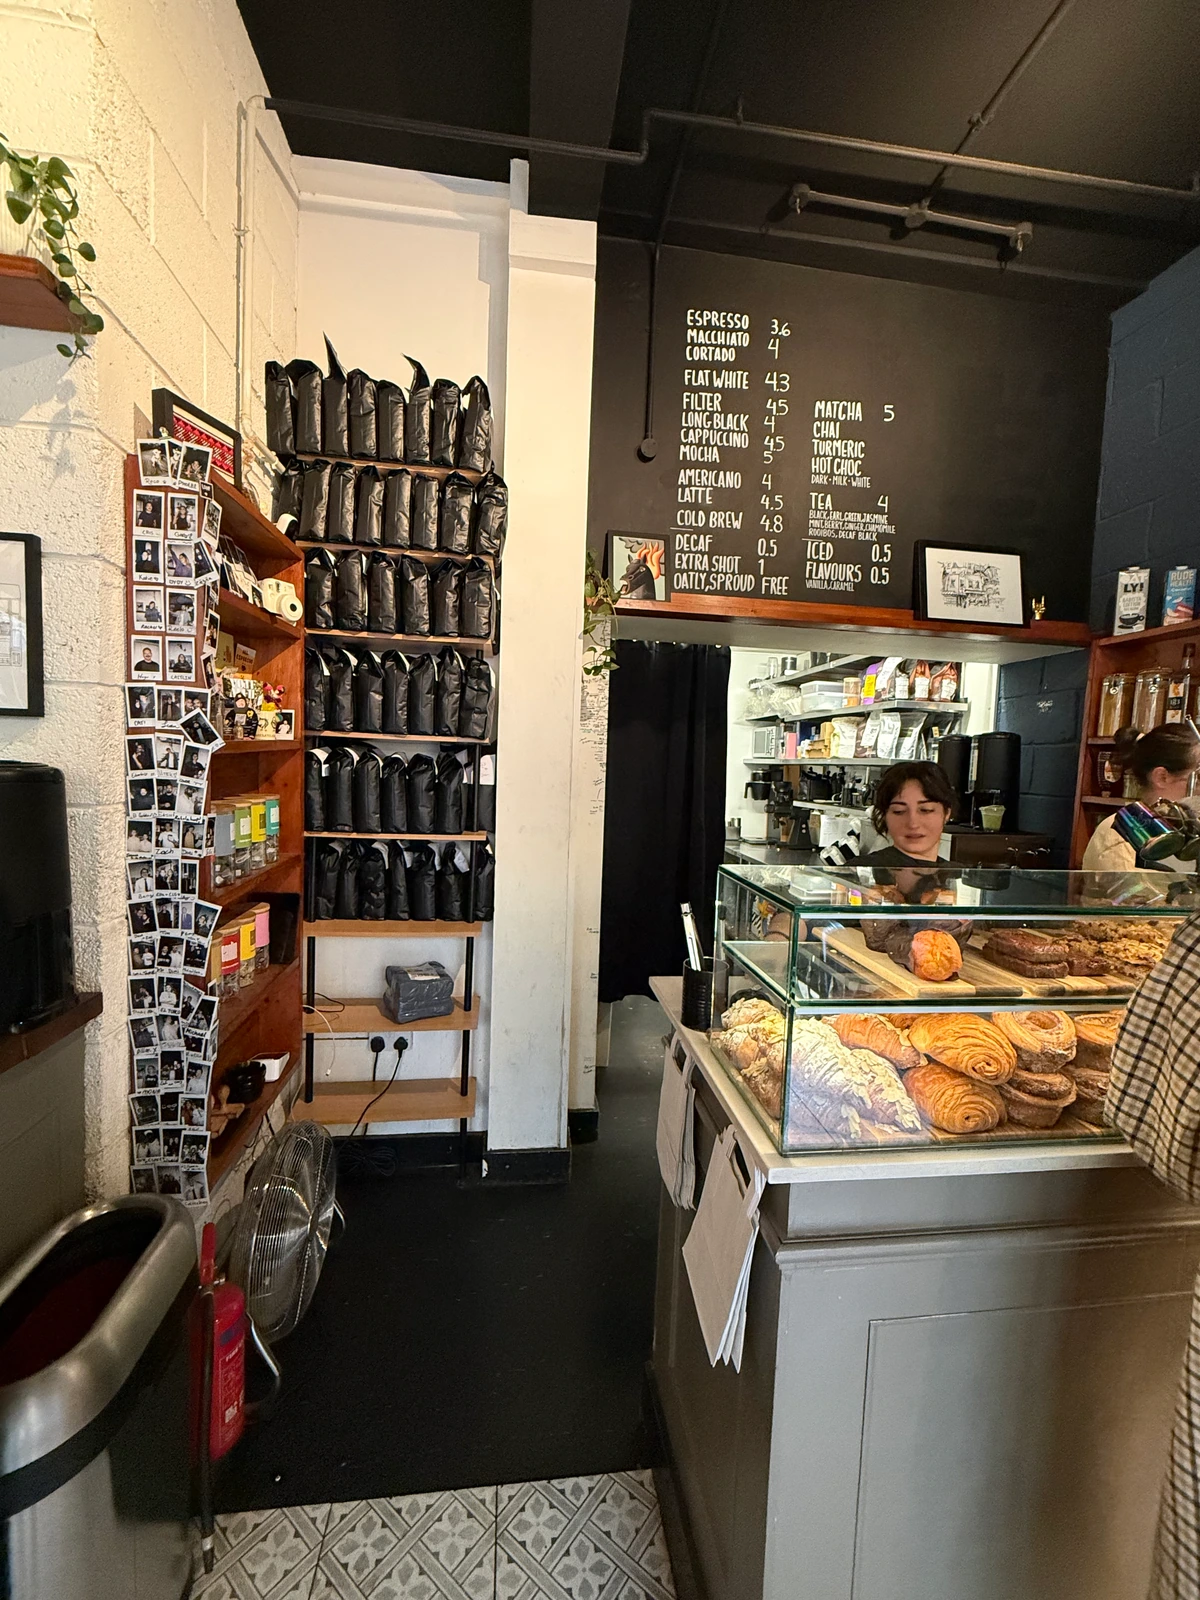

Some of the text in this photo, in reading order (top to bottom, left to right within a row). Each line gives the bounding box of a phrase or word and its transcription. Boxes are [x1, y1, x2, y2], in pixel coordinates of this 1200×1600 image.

[687, 309, 790, 336] ESPRESSO 3.6
[686, 346, 736, 362] CORTADO
[687, 329, 780, 359] MACCHIATO 4
[684, 370, 790, 392] FLAT WHITE 4.3
[682, 392, 788, 416] FILTER 4.5
[814, 401, 895, 422] MATCHA 5
[682, 412, 775, 433] LONG BLACK 4
[813, 421, 840, 439] CHAI
[680, 428, 785, 452] CAPPUCCINO 4.5
[812, 439, 866, 458] TURMERIC
[680, 445, 774, 464] MOCHA 5
[812, 457, 862, 477] HOT CHOC
[678, 468, 772, 490] AMERICANO 4
[811, 474, 871, 488] DARK MILK WHITE
[678, 487, 784, 510] LATTE 4.5
[810, 492, 888, 512] TEA 4
[676, 510, 783, 533] COLD BREW 4.8
[676, 534, 778, 557] DECAF 0.5
[838, 530, 856, 540] DECAF
[858, 532, 878, 541] BLACK
[806, 541, 892, 562] ICED 0.5
[674, 552, 764, 576] EXTRA SHOT 1
[806, 561, 890, 584] FLAVOURS 0.5
[762, 576, 789, 596] FREE
[1172, 571, 1194, 580] RUDE
[1124, 583, 1144, 593] LY!
